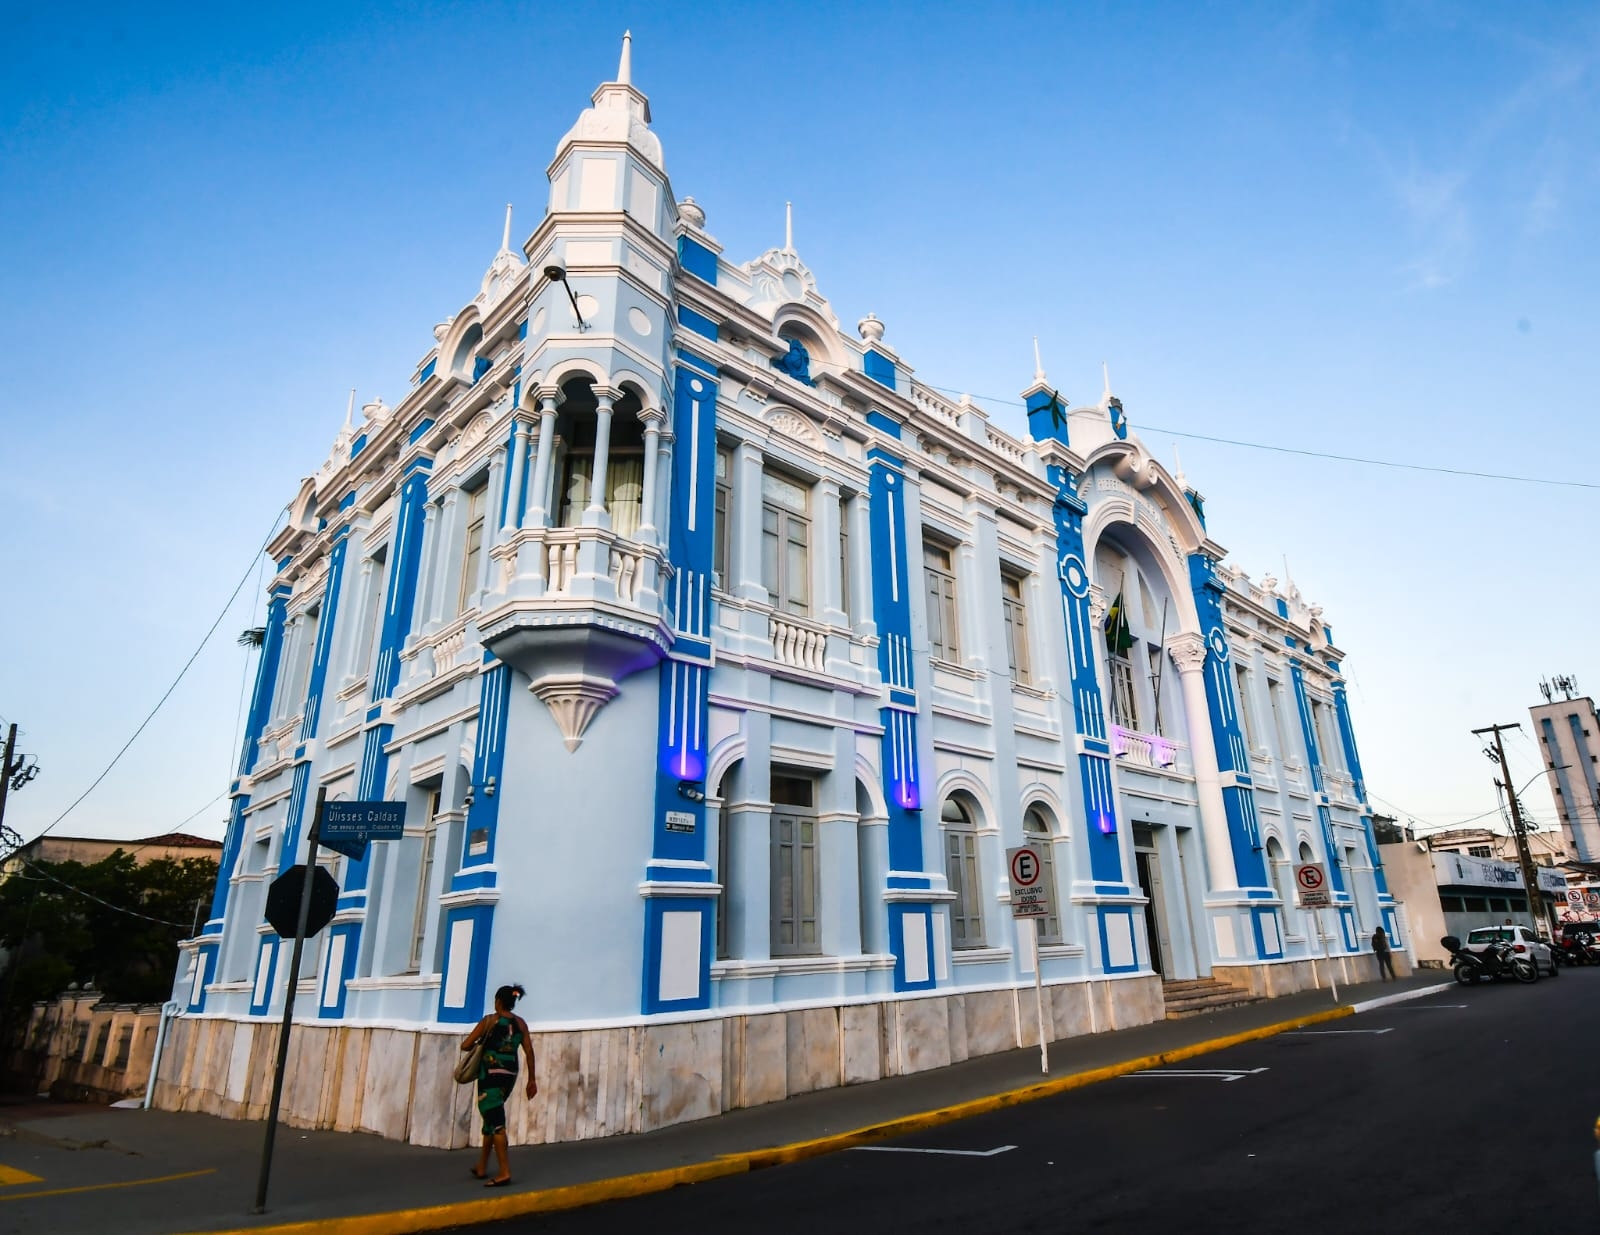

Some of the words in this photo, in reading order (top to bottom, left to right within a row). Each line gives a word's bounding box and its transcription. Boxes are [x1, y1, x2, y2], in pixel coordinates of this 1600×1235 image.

[329, 810, 363, 822] Ulisses
[367, 810, 398, 822] Caldas
[1020, 856, 1032, 879] E
[1305, 870, 1316, 884] E
[1015, 887, 1043, 896] EXCLUSIVO
[1021, 895, 1037, 903] IDOSO
